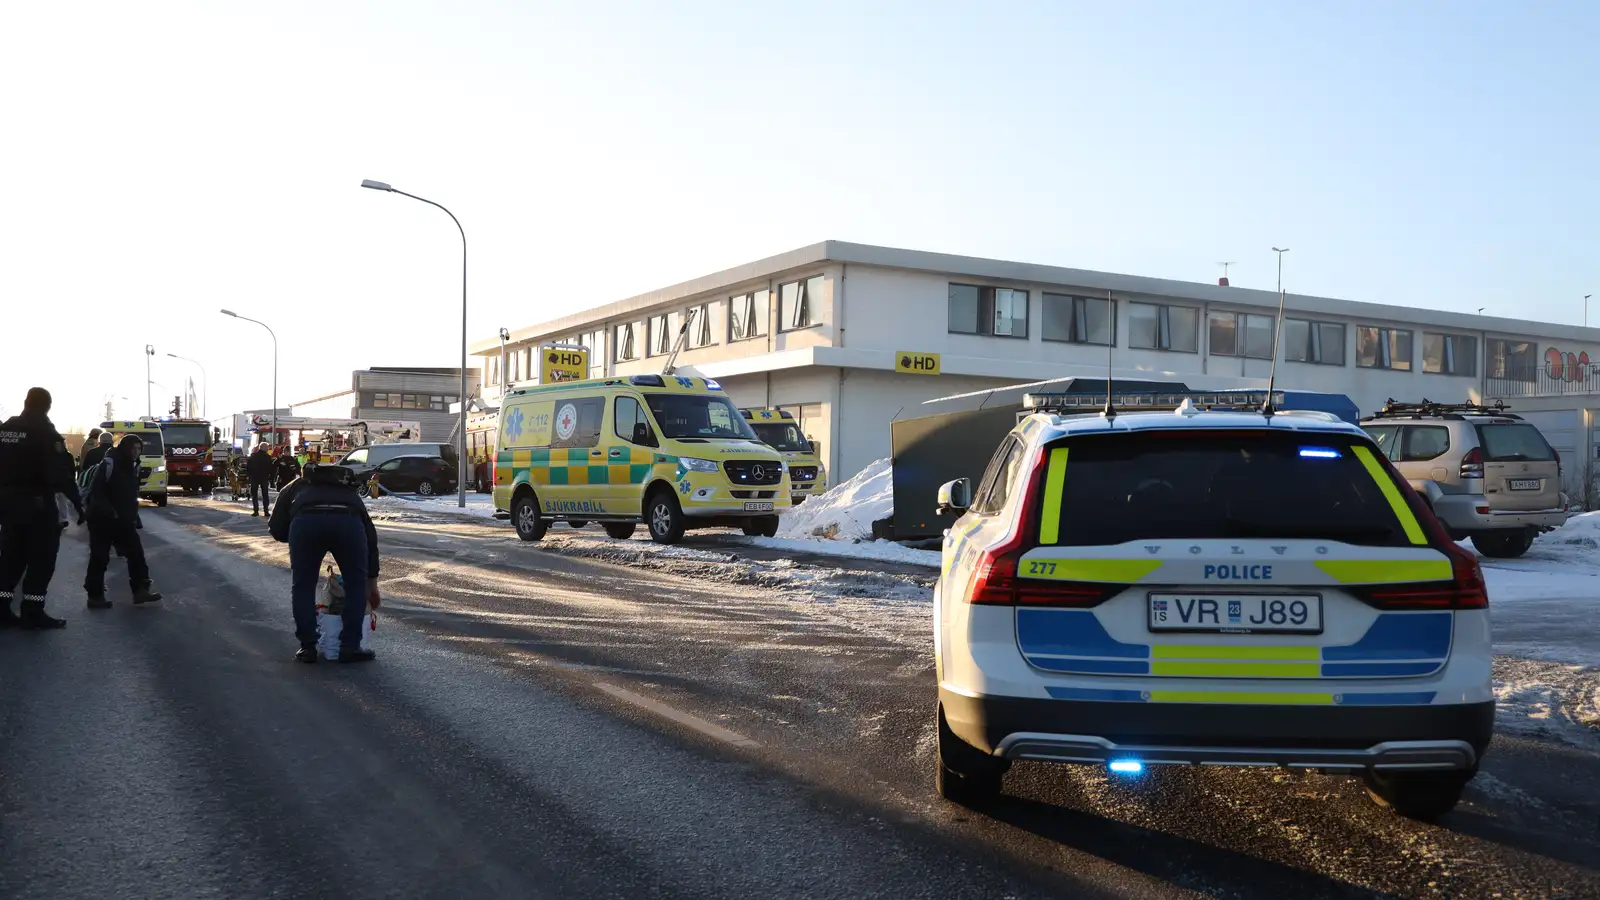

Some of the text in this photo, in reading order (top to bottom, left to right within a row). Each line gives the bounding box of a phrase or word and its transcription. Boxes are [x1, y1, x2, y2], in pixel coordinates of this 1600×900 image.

[561, 353, 583, 366] HD
[913, 356, 936, 370] HD
[536, 414, 549, 427] 112
[1143, 545, 1329, 555] VOLVO
[1030, 561, 1057, 575] 277
[1204, 564, 1273, 580] POLICE
[1153, 611, 1168, 622] IS
[1175, 598, 1308, 625] VR 23 J89
